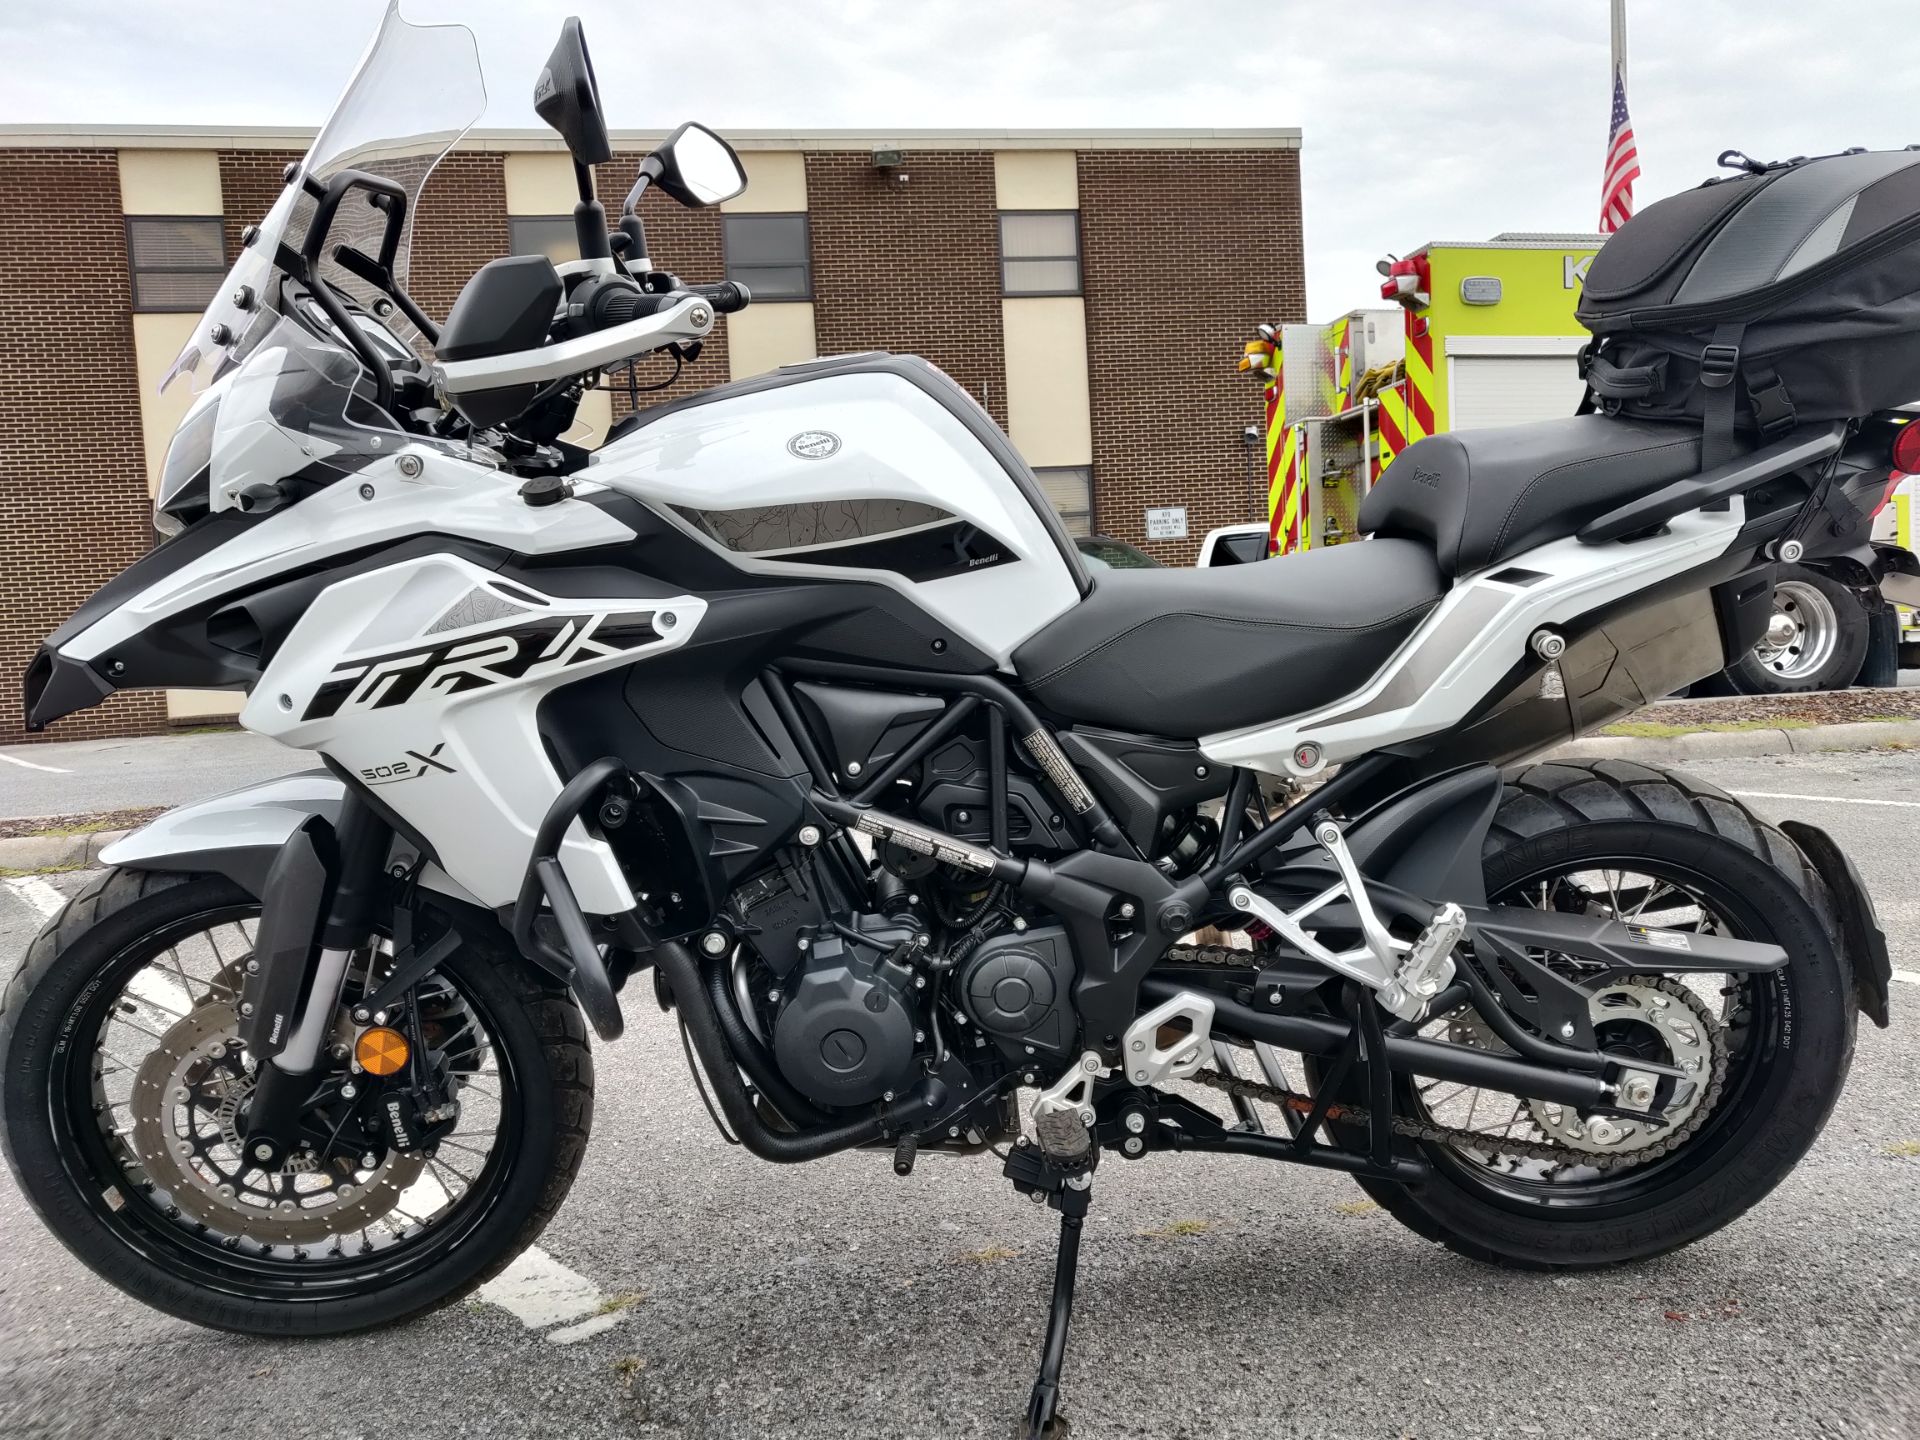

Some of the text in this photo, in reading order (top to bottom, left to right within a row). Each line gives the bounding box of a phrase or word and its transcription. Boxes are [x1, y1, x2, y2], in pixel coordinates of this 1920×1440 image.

[969, 553, 999, 567] Benelli
[316, 612, 630, 716] TRK
[269, 1013, 284, 1045] Benelli
[387, 1101, 410, 1148] Benelli
